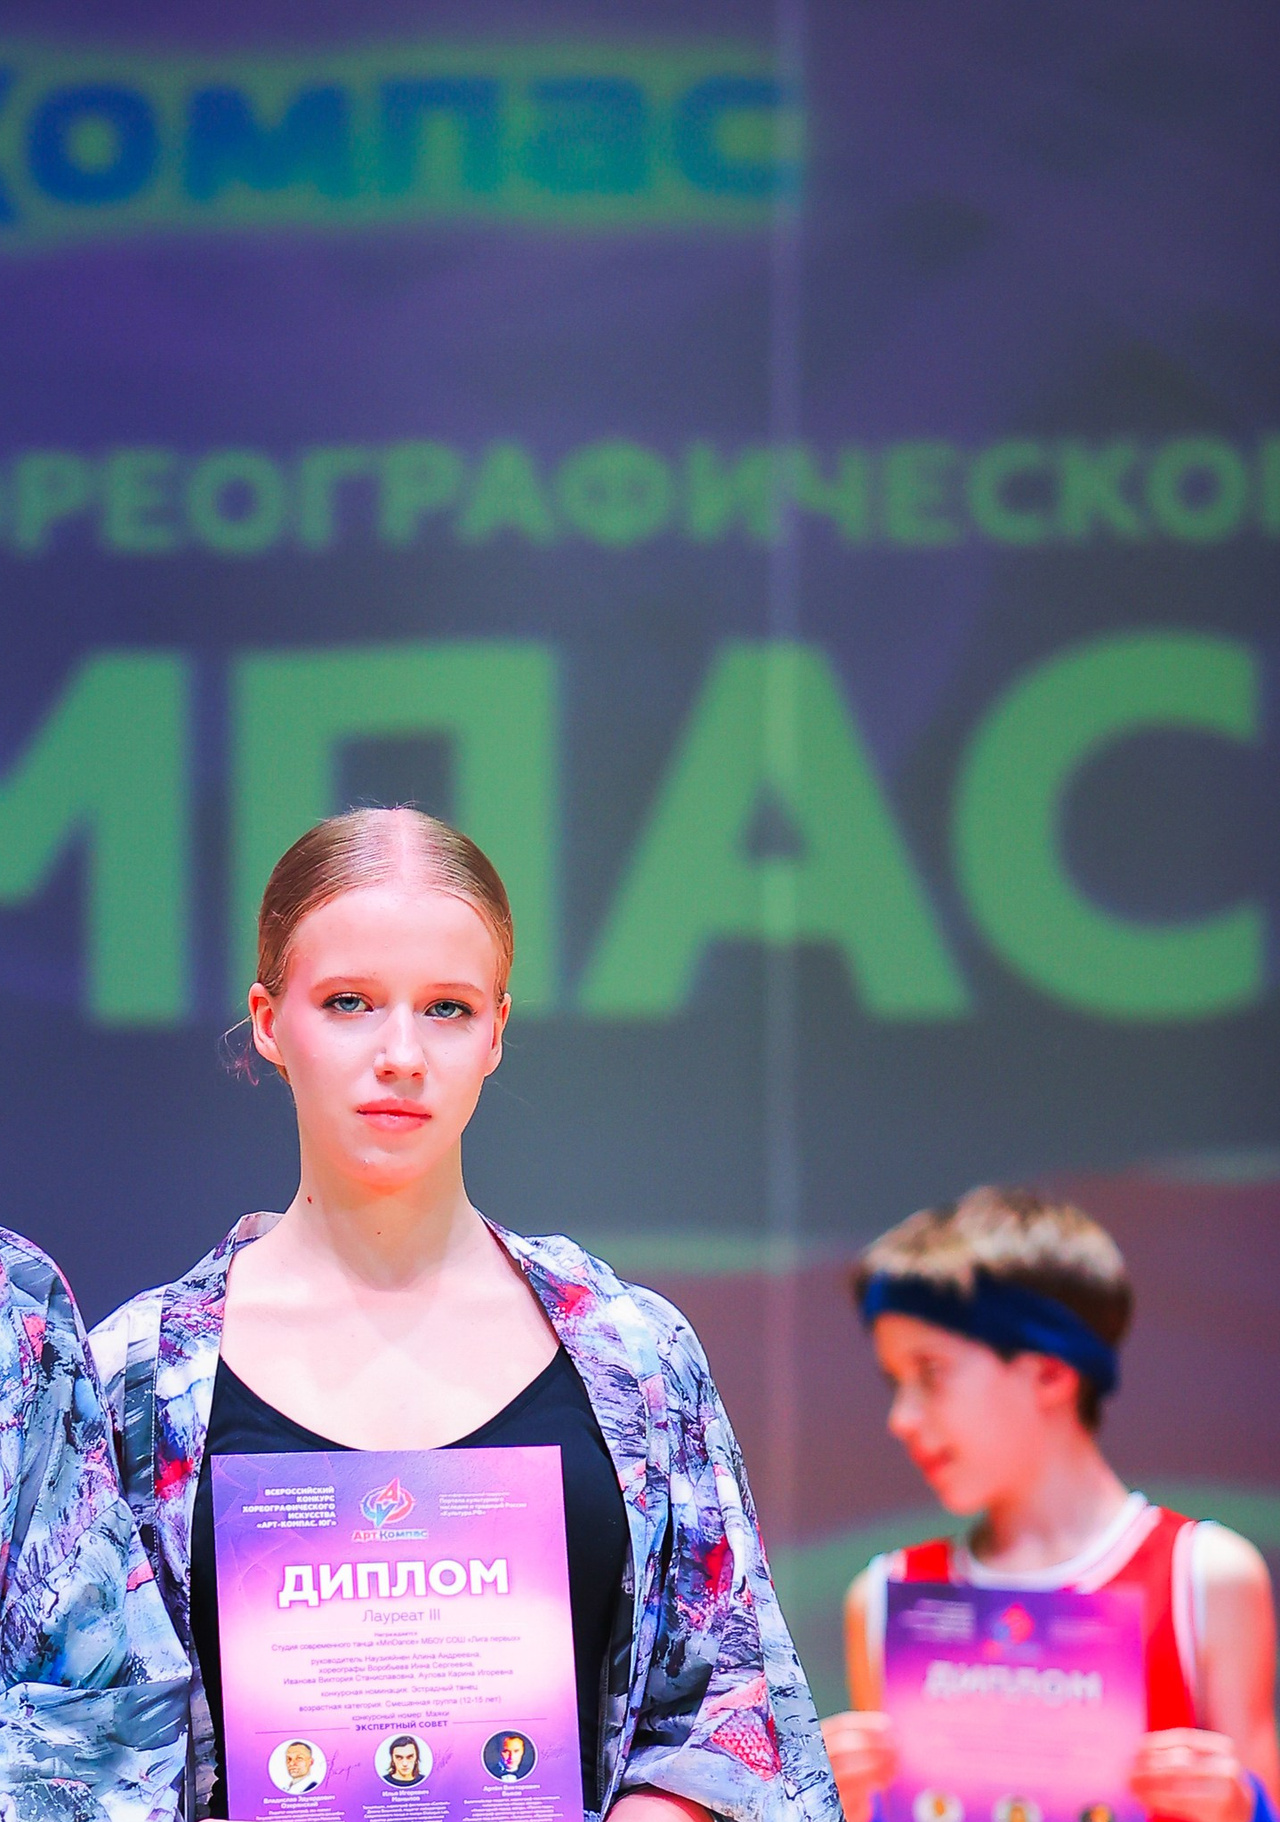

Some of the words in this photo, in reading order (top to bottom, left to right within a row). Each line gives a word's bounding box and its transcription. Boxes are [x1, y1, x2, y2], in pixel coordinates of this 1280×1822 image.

[264, 1486, 335, 1496] ВСЕРОССИЙСКИЙ
[296, 1495, 335, 1503] КОНКУРС
[242, 1503, 336, 1513] ХОРЕОГРАФИЧЕСКОГО
[287, 1511, 336, 1519] ИСКУССТВА
[277, 1558, 510, 1608] ДИПЛОМ
[362, 1609, 424, 1624] Лауреат
[429, 1608, 441, 1621] III
[271, 1644, 298, 1652] Студия
[300, 1642, 351, 1651] современного
[421, 1636, 444, 1644] МБОУ
[446, 1635, 466, 1644] СОШ
[412, 1652, 436, 1660] Алина
[318, 1676, 354, 1684] Виктория
[448, 1670, 476, 1678] Карина
[433, 1699, 458, 1708] группа
[355, 1721, 417, 1732] ЭКСПЕРТНЫЙ
[419, 1720, 448, 1729] СОВЕТ
